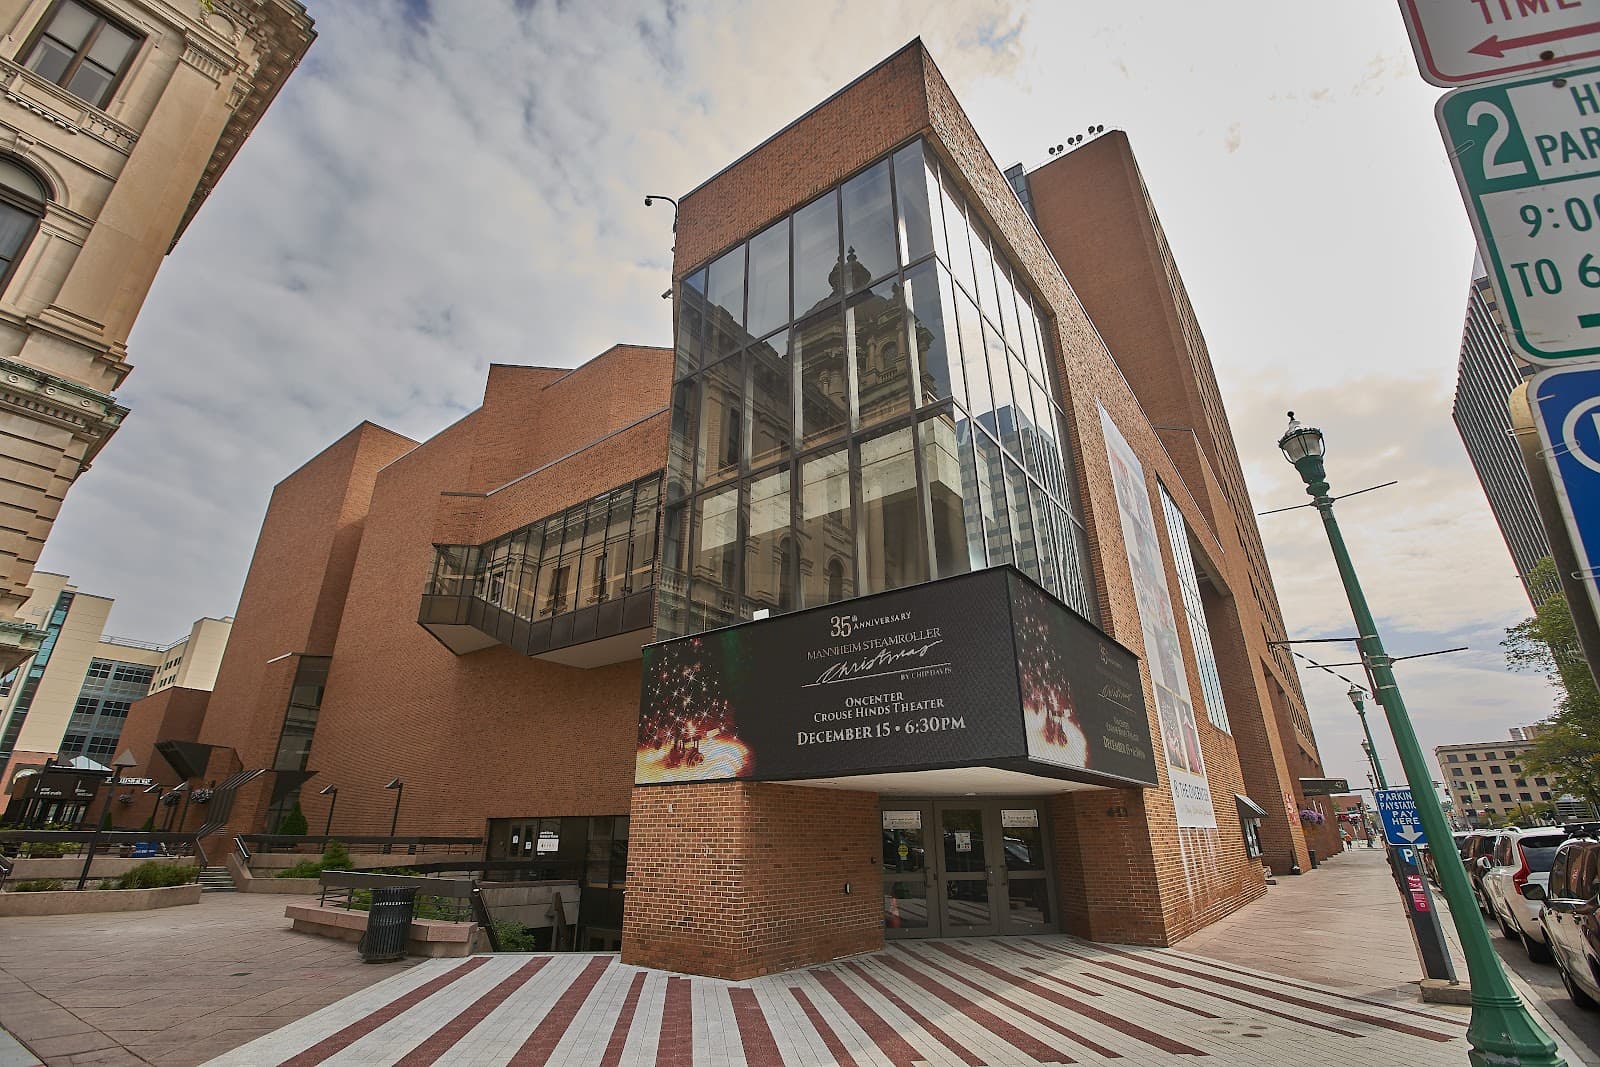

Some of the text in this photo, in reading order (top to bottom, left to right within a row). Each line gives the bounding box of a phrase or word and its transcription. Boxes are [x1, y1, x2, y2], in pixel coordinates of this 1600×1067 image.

[1569, 82, 1600, 116] H
[1466, 100, 1528, 180] 2
[1519, 193, 1600, 238] 9:0
[1510, 258, 1563, 298] TO
[853, 611, 912, 631] ANNIVERSARY
[807, 627, 942, 661] MANNHEIM STEAMROLLER
[815, 639, 944, 684] Christmas
[814, 698, 944, 723] CROUSE HINDS THEATER
[845, 691, 904, 708] ONCENTER
[797, 715, 966, 746] DECEMBER 15 6:30PM
[1378, 791, 1412, 802] PARKIN
[1391, 817, 1421, 825] HERE
[1392, 810, 1413, 818] PAY
[1403, 849, 1413, 863] P
